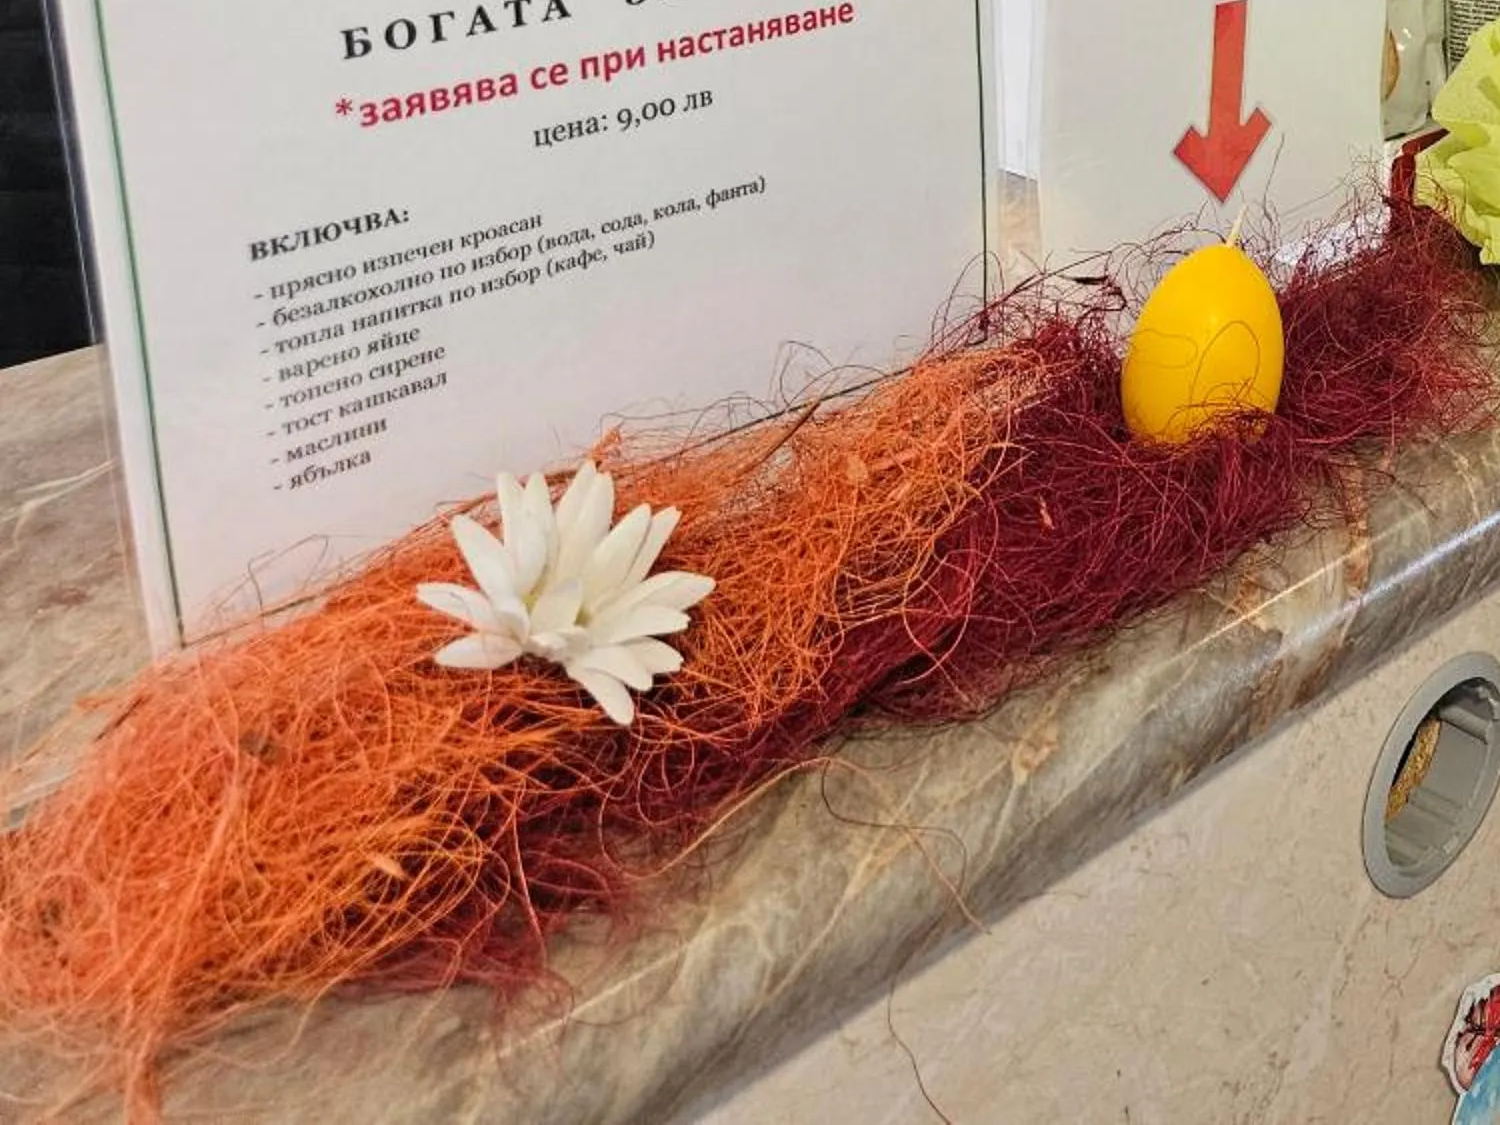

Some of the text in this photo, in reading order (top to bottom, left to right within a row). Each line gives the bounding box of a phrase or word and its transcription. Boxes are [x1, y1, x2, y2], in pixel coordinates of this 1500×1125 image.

[529, 59, 570, 92] се
[579, 45, 648, 85] при
[655, 0, 856, 65] настаняване
[532, 84, 715, 149] цена: 9,00 лв
[269, 260, 358, 302] прясно
[361, 236, 456, 276] изпечен
[459, 211, 544, 251] кроасан
[272, 267, 436, 329] безалкохолно
[439, 261, 467, 283] по
[470, 239, 534, 274] избор
[536, 225, 597, 256] (вода,
[600, 212, 649, 238] сода,
[652, 196, 702, 224] кола,
[704, 175, 768, 214] фанта)
[274, 321, 346, 357] топла
[350, 291, 445, 333] напитка
[448, 283, 478, 307] по
[480, 263, 543, 297] избор
[545, 244, 610, 281] (кафе,
[611, 229, 657, 256] чай)
[277, 345, 362, 385] варено
[365, 324, 422, 356] яйце
[279, 371, 364, 414] топено
[367, 344, 447, 383] сирене
[280, 408, 332, 437] тост
[337, 370, 449, 421] кашкавал
[284, 418, 389, 464] маслини
[288, 449, 372, 492] ябълка
